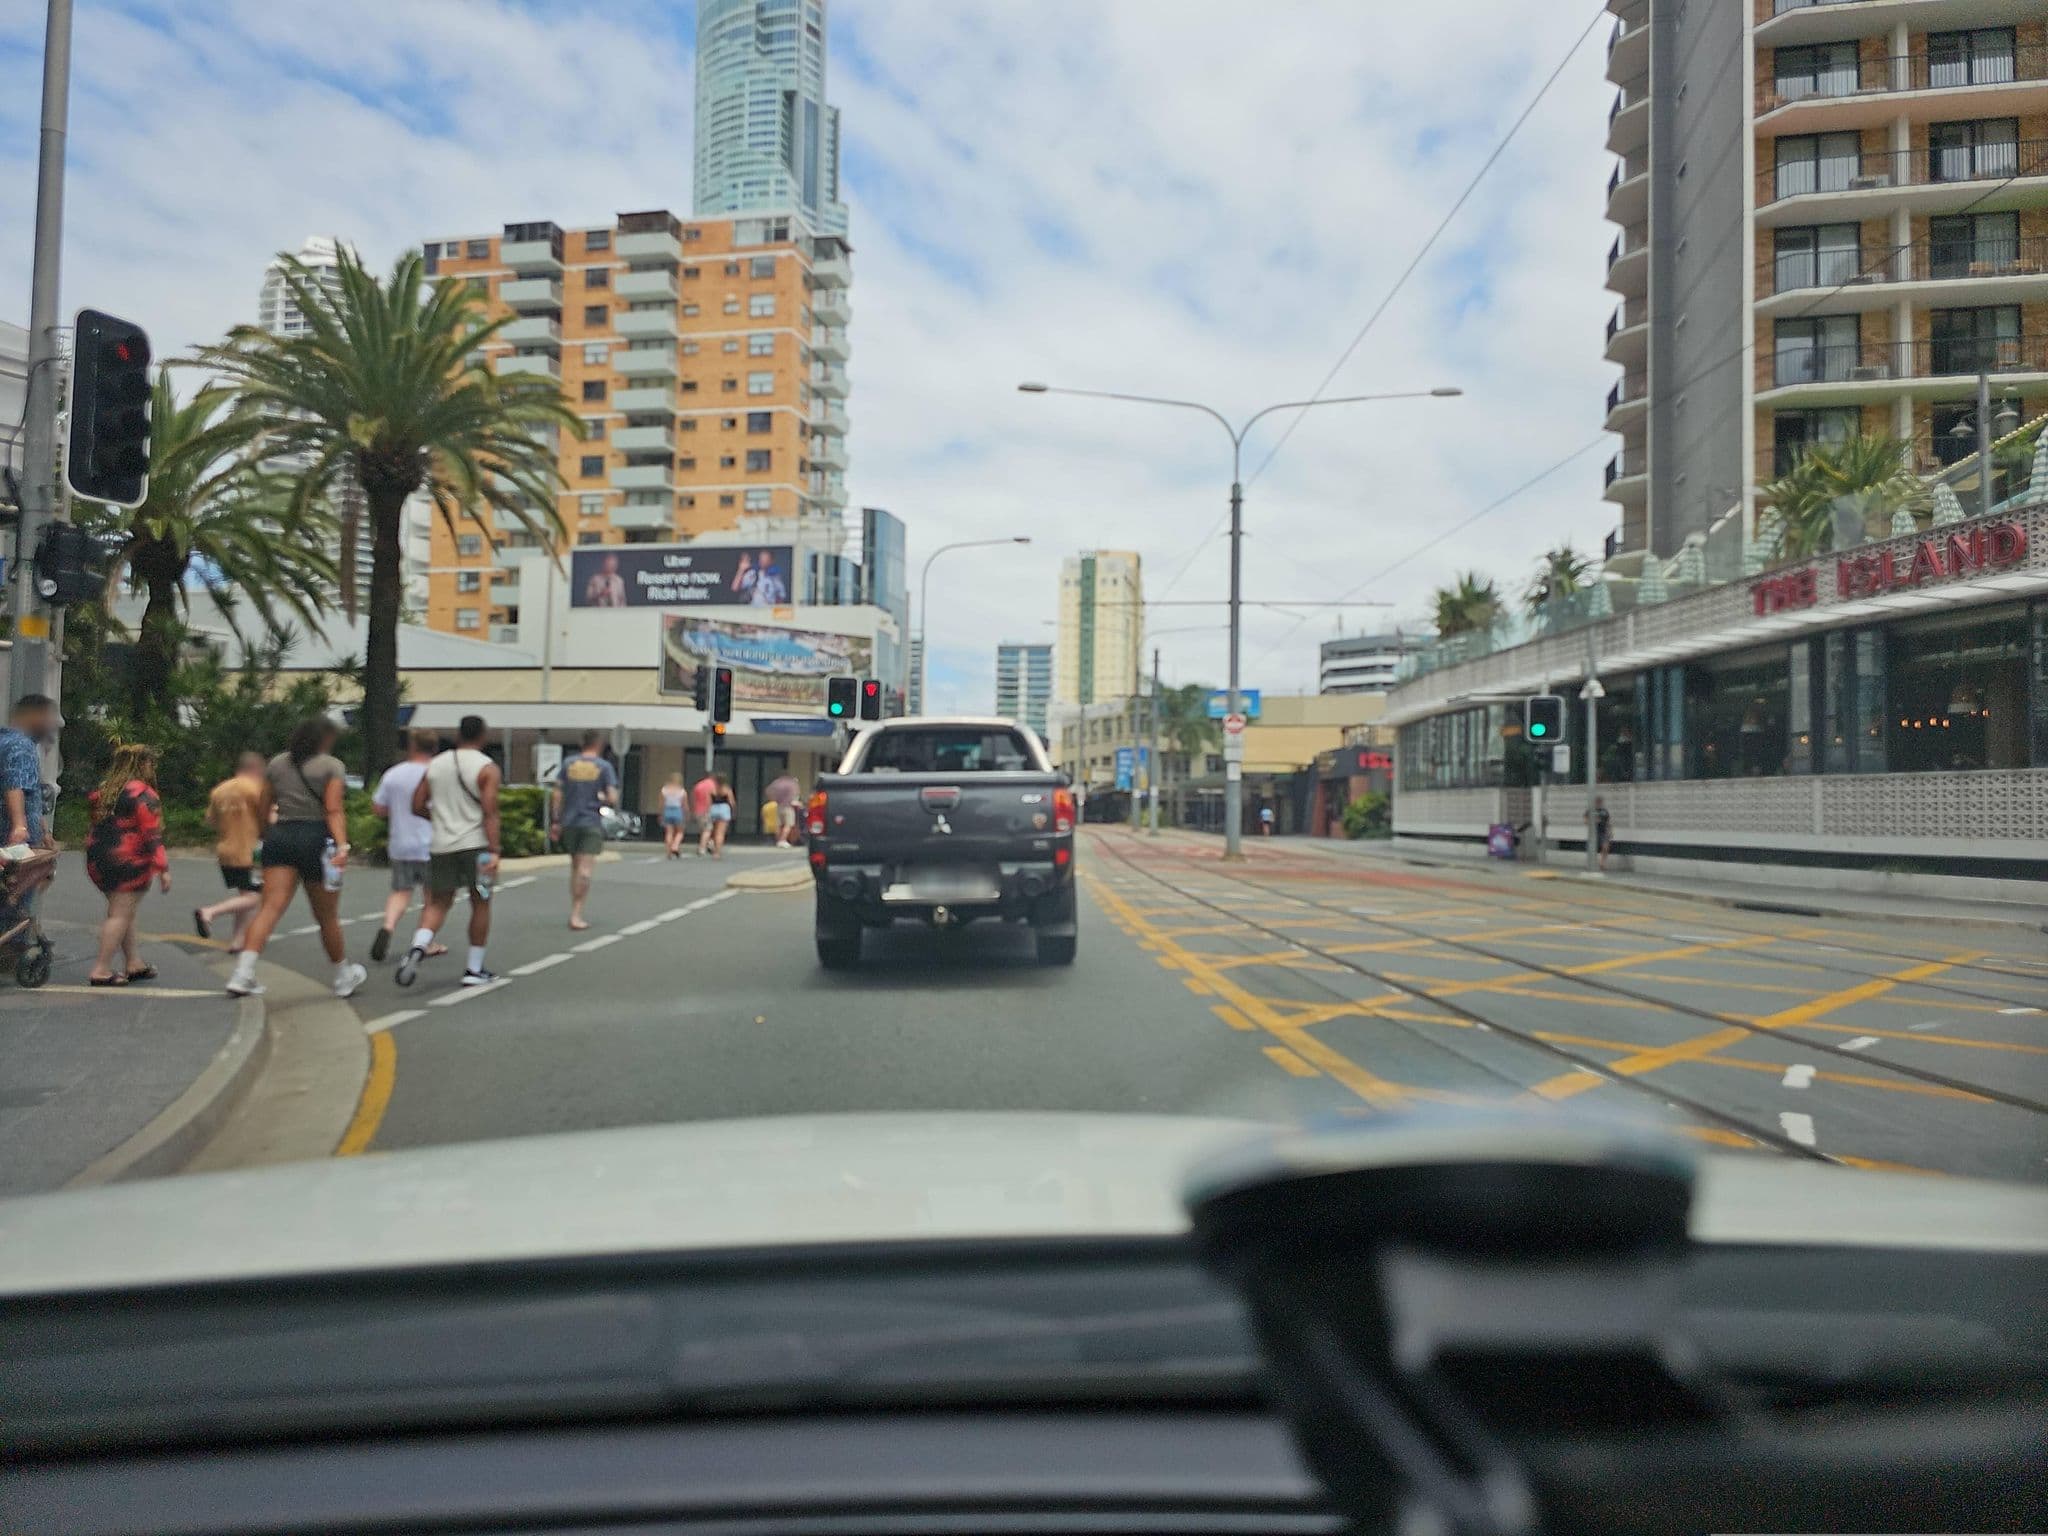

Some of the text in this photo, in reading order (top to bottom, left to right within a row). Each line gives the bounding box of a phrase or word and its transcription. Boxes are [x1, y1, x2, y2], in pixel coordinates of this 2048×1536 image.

[663, 554, 692, 569] Uber
[1753, 522, 2029, 616] THE ISLAND
[637, 571, 689, 585] Reserve
[647, 586, 677, 600] Ride
